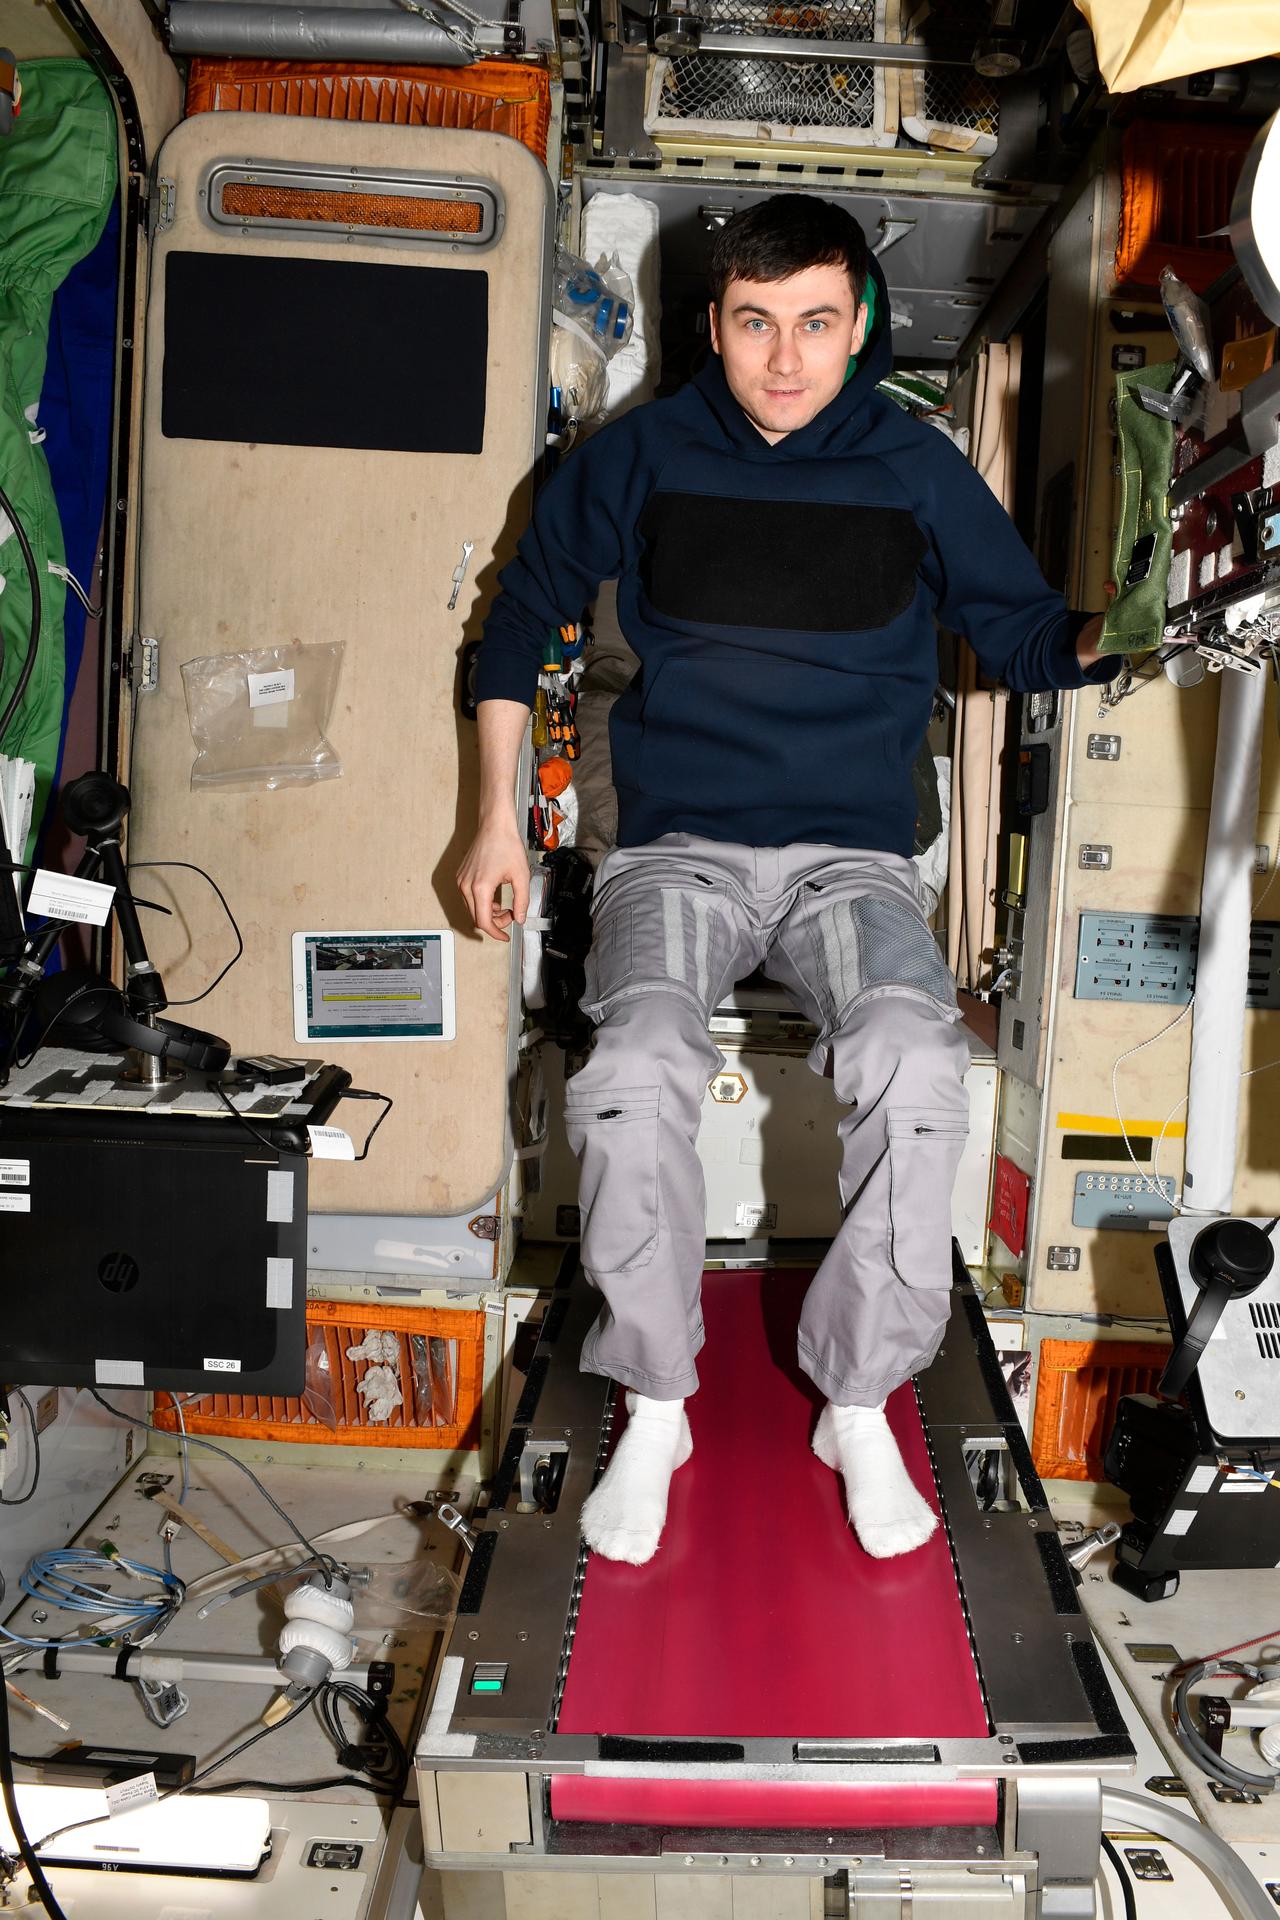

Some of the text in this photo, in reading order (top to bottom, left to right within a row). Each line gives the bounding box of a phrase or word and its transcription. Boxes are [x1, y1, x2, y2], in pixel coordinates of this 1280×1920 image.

[103, 1253, 135, 1293] hp
[207, 1360, 236, 1370] SSC 26
[102, 1863, 119, 1872] A96
